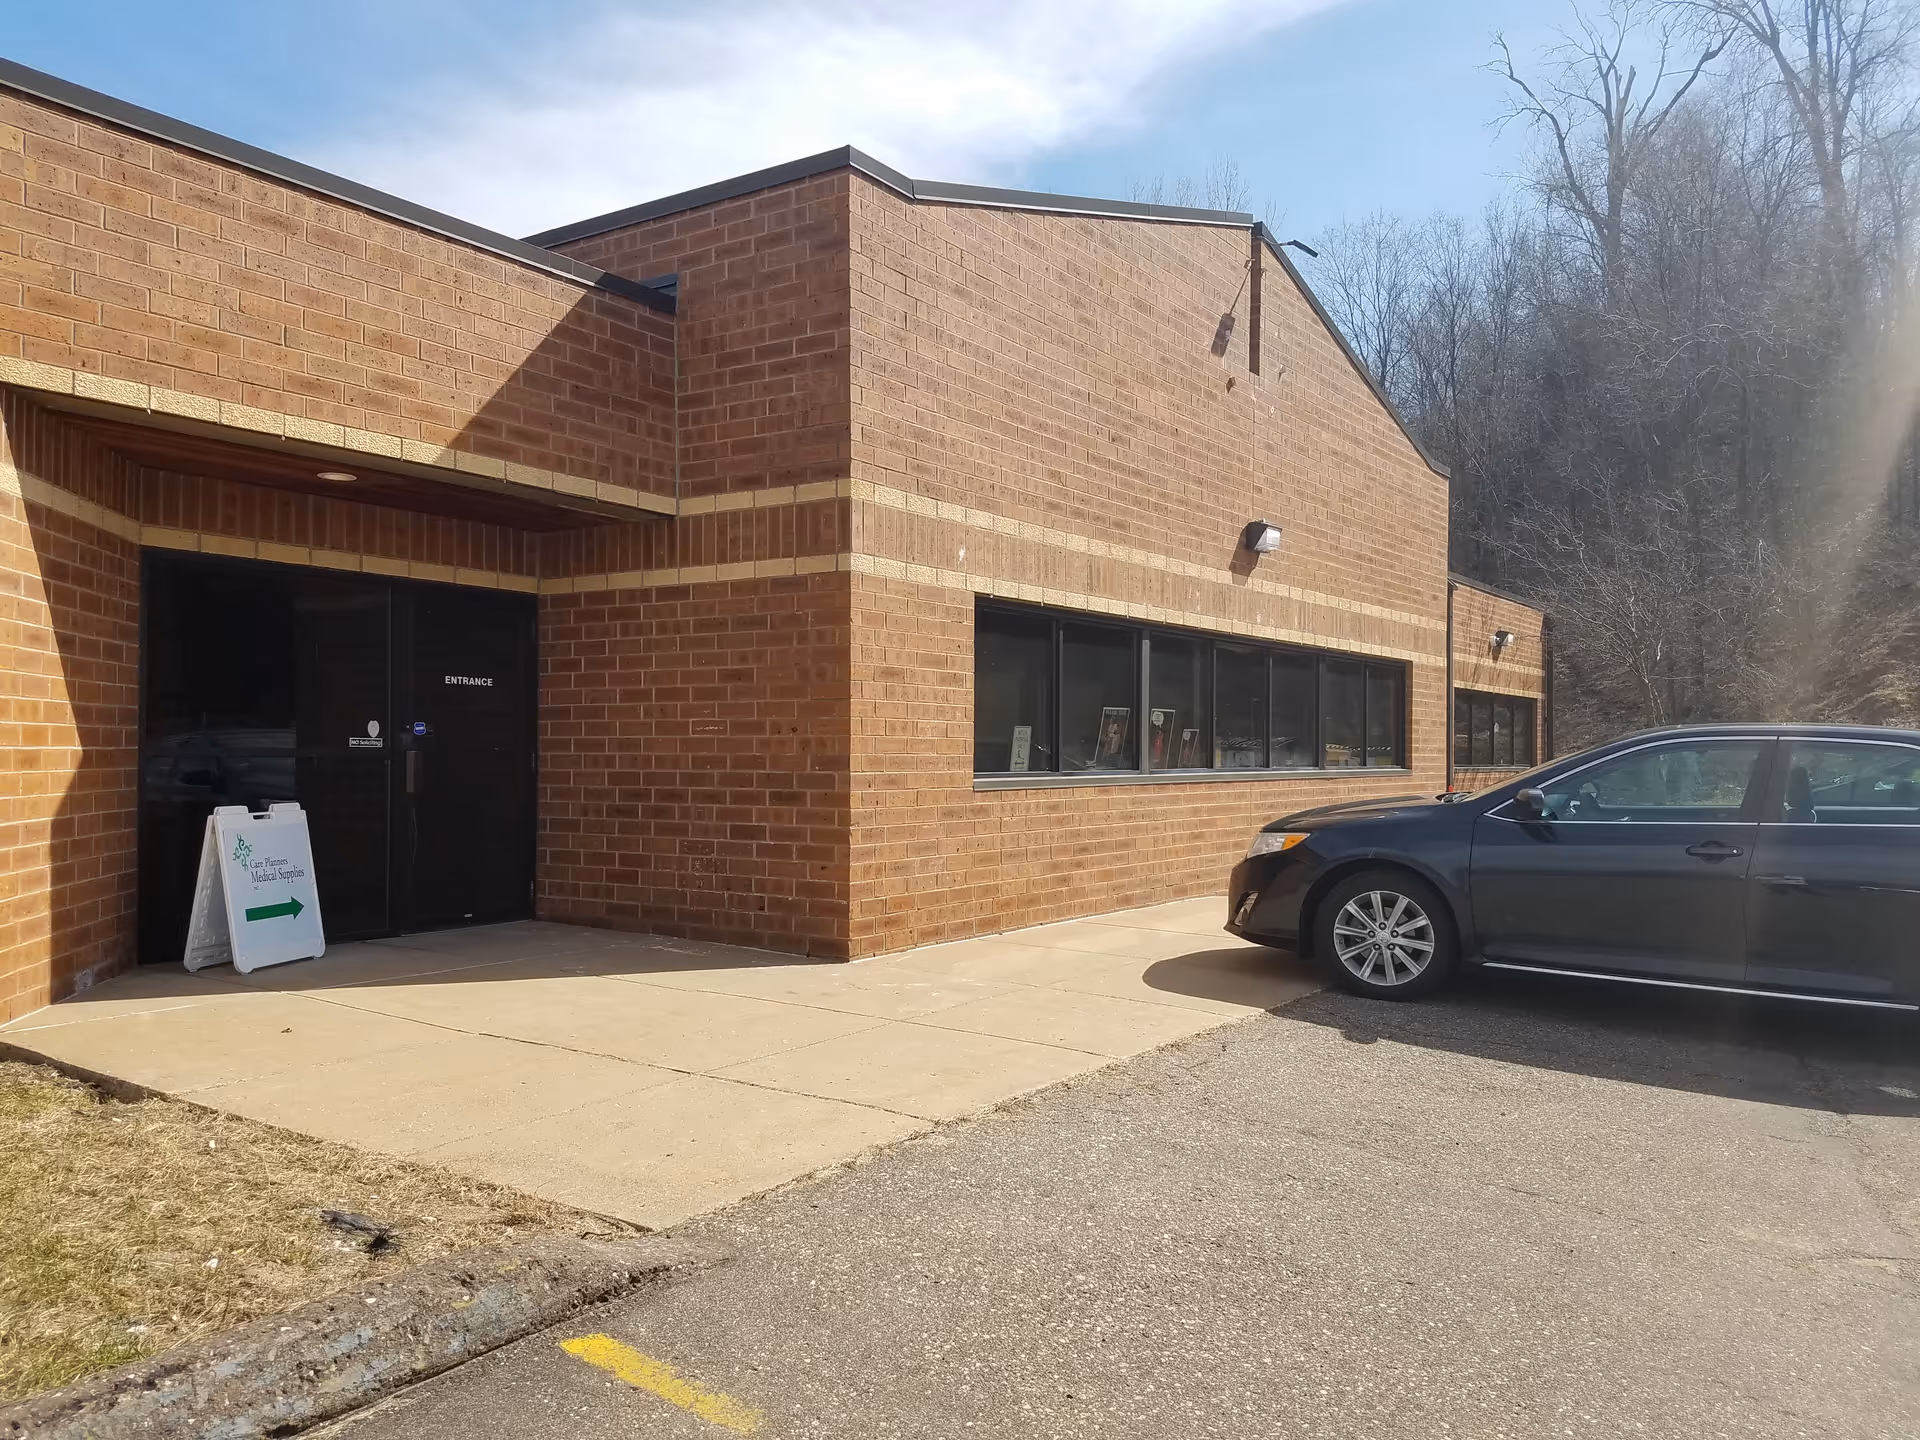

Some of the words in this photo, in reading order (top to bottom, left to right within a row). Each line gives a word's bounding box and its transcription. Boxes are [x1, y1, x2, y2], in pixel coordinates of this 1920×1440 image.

[445, 675, 493, 687] ENTRANCE
[249, 859, 264, 869] Care
[264, 857, 289, 867] Planners
[251, 868, 277, 884] Medical
[278, 865, 305, 884] Supplies
